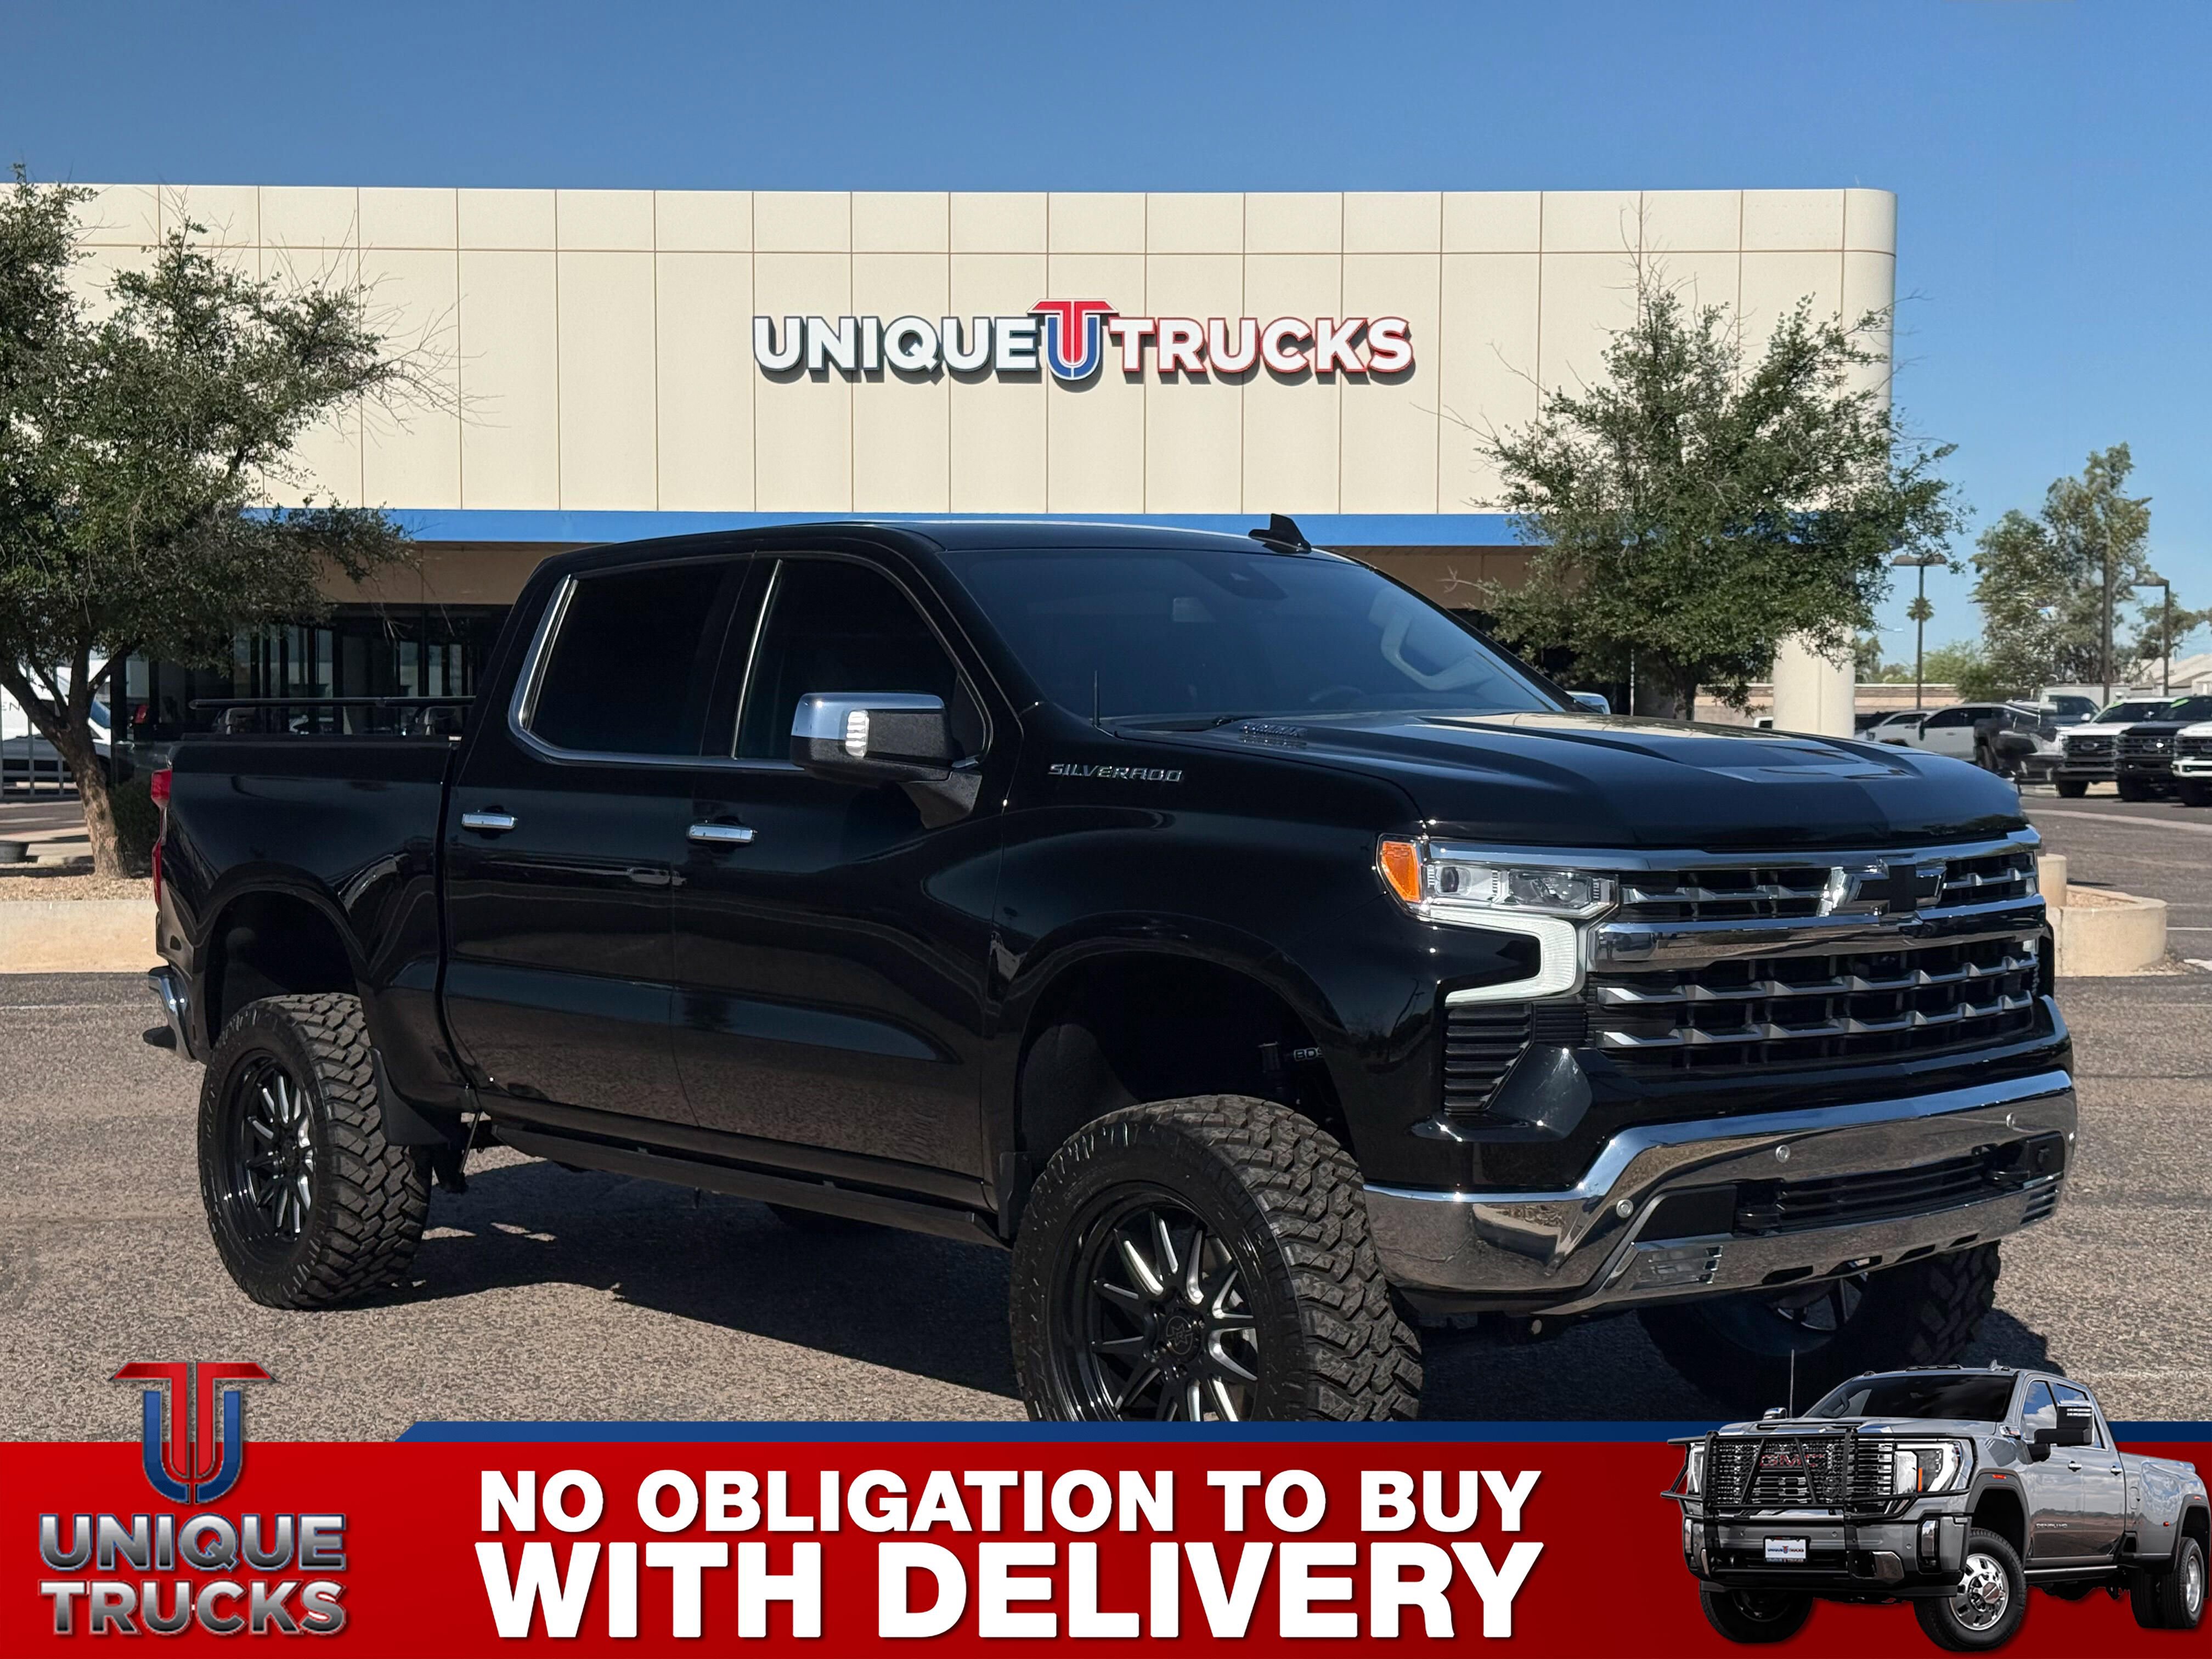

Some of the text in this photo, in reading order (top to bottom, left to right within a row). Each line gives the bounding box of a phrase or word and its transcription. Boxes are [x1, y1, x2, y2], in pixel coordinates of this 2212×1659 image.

[752, 315, 1038, 374] UNIQUE
[1108, 317, 1415, 374] TRUCKS
[1048, 763, 1182, 782] SILVERADO
